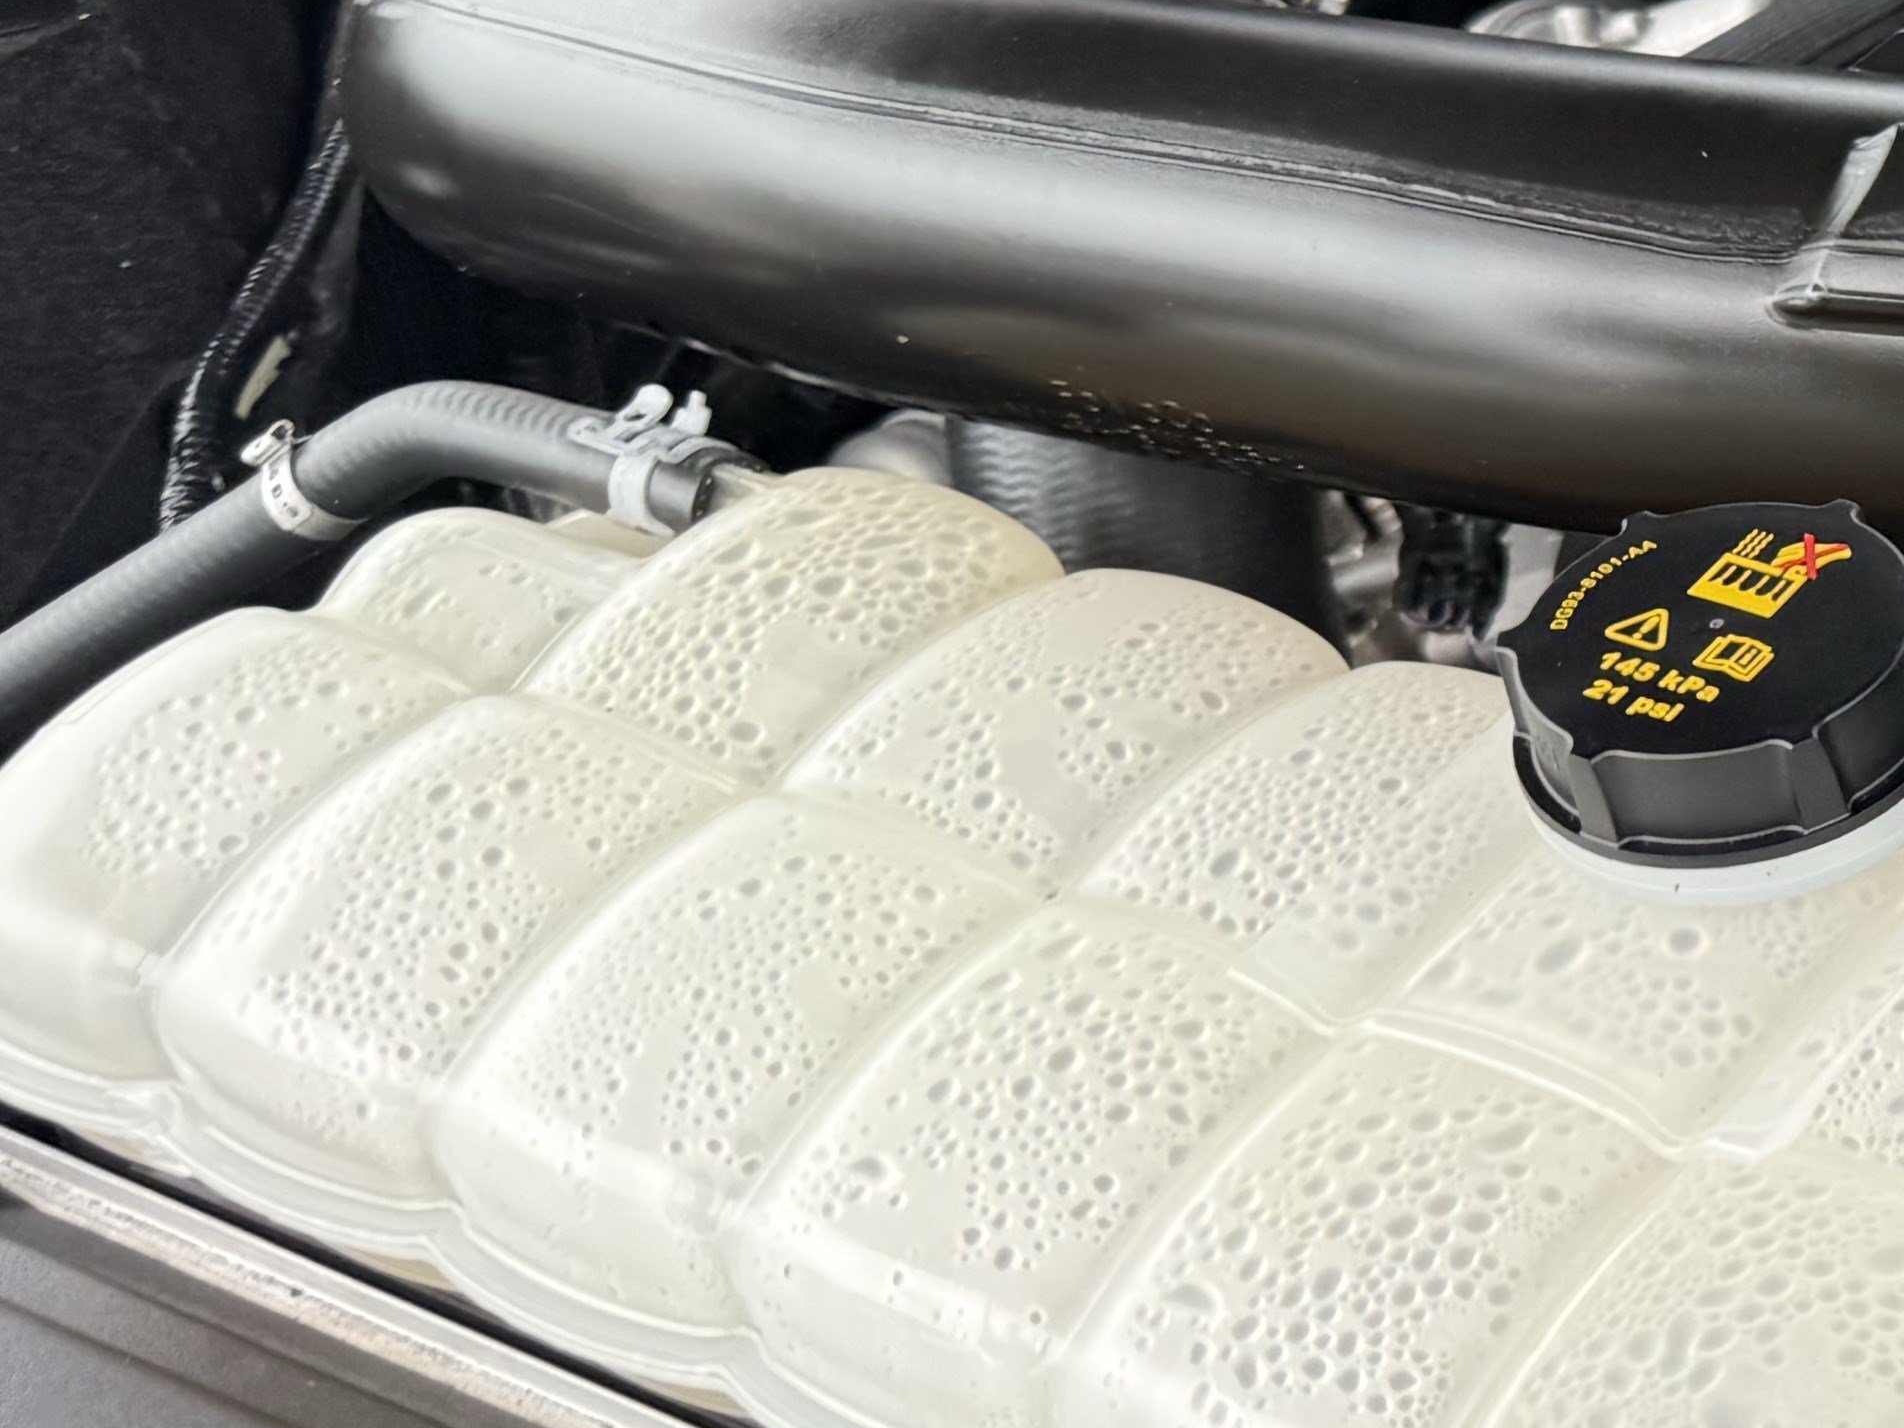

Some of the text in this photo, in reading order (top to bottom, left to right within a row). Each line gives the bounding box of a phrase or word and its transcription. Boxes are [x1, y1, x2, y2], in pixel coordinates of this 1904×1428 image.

[1549, 540, 1658, 631] DG93-8101-AA
[1582, 679, 1685, 722] 21 psi
[1600, 651, 1720, 703] 145 kPa
